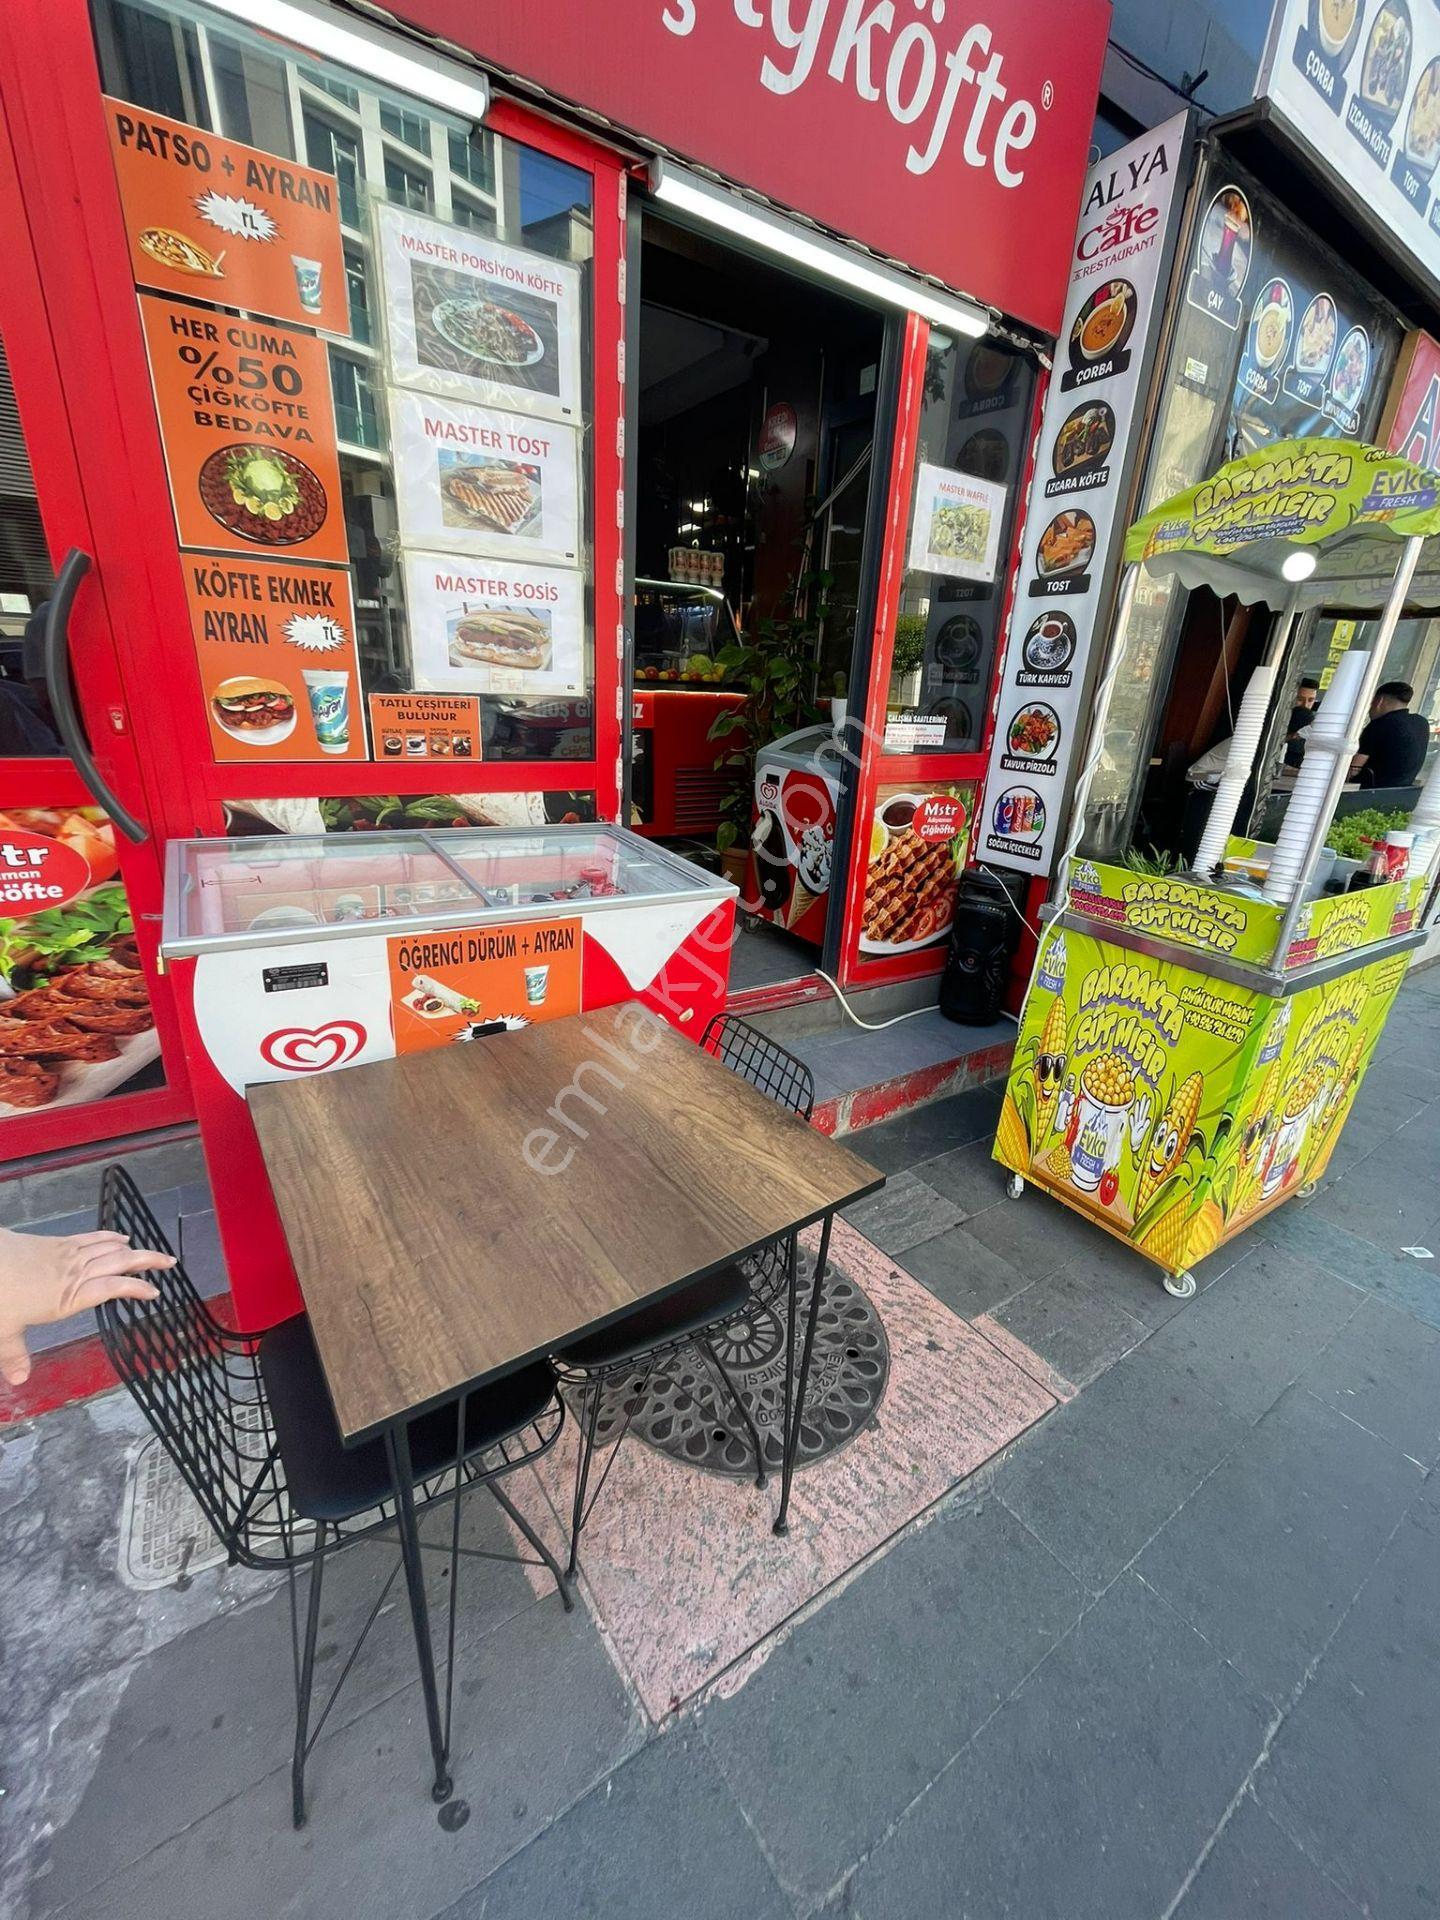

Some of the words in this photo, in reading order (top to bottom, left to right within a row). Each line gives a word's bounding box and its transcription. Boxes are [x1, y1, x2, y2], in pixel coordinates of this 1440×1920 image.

[1306, 49, 1335, 97] ÇORBA
[1349, 101, 1372, 142] IZGARA
[1371, 131, 1391, 163] KÖFTE
[115, 113, 211, 173] PATSO
[221, 155, 235, 177] +
[246, 159, 331, 213] AYRAN
[1083, 144, 1169, 217] ALYA
[1404, 170, 1420, 199] TOST
[242, 212, 259, 231] TL
[1077, 203, 1159, 261] Cafe
[401, 234, 457, 263] MASTER
[461, 252, 524, 284] PORSİYON
[527, 272, 563, 296] KÖFTE
[1083, 234, 1157, 278] RESTAURANT
[1207, 291, 1223, 310] ÇAY
[170, 315, 220, 343] HER
[227, 327, 297, 360] CUMA
[178, 345, 303, 396] %50
[1076, 359, 1113, 386] ÇORBA
[1246, 367, 1268, 392] ÇORBA
[188, 384, 309, 420] ÇİĞKÖFTE
[1298, 379, 1312, 397] TOST
[194, 411, 314, 443] BEDAVA
[424, 417, 502, 449] MASTER
[506, 434, 550, 457] TOST
[939, 482, 965, 497] MASTER
[1047, 477, 1077, 494] IZGARA
[1079, 470, 1108, 488] KÖFTE
[1193, 451, 1352, 516] BARDAKTA
[1380, 494, 1417, 508] FRESH
[194, 562, 262, 601] KÖFTE
[268, 576, 335, 607] EKMEK
[435, 574, 508, 596] MASTER
[513, 582, 558, 601] SOSİS
[1046, 580, 1071, 592] TOST
[204, 609, 269, 644] AYRAN
[323, 626, 337, 641] TL
[1019, 671, 1037, 684] TÜRK
[1038, 671, 1070, 685] KAHVESİ
[379, 698, 412, 708] TATLI
[398, 711, 457, 721] BULUNUR
[1003, 758, 1025, 772] TAVUK
[1025, 759, 1056, 775] PİRZOLA
[924, 803, 958, 816] Mstr
[920, 825, 955, 836] Çiğköfte
[988, 836, 1008, 850] SOĞUK
[1008, 840, 1041, 859] İÇECEKLER
[1121, 882, 1247, 932] BARDAKTA
[1127, 901, 1171, 928] SÜT
[399, 934, 464, 971] ÖĞRENCİ
[468, 930, 517, 963] DÜRÜM
[521, 937, 529, 955] +
[534, 927, 574, 953] AYRAN
[1081, 963, 1185, 1042] BARDAKTA
[1077, 1003, 1118, 1050] SÜT
